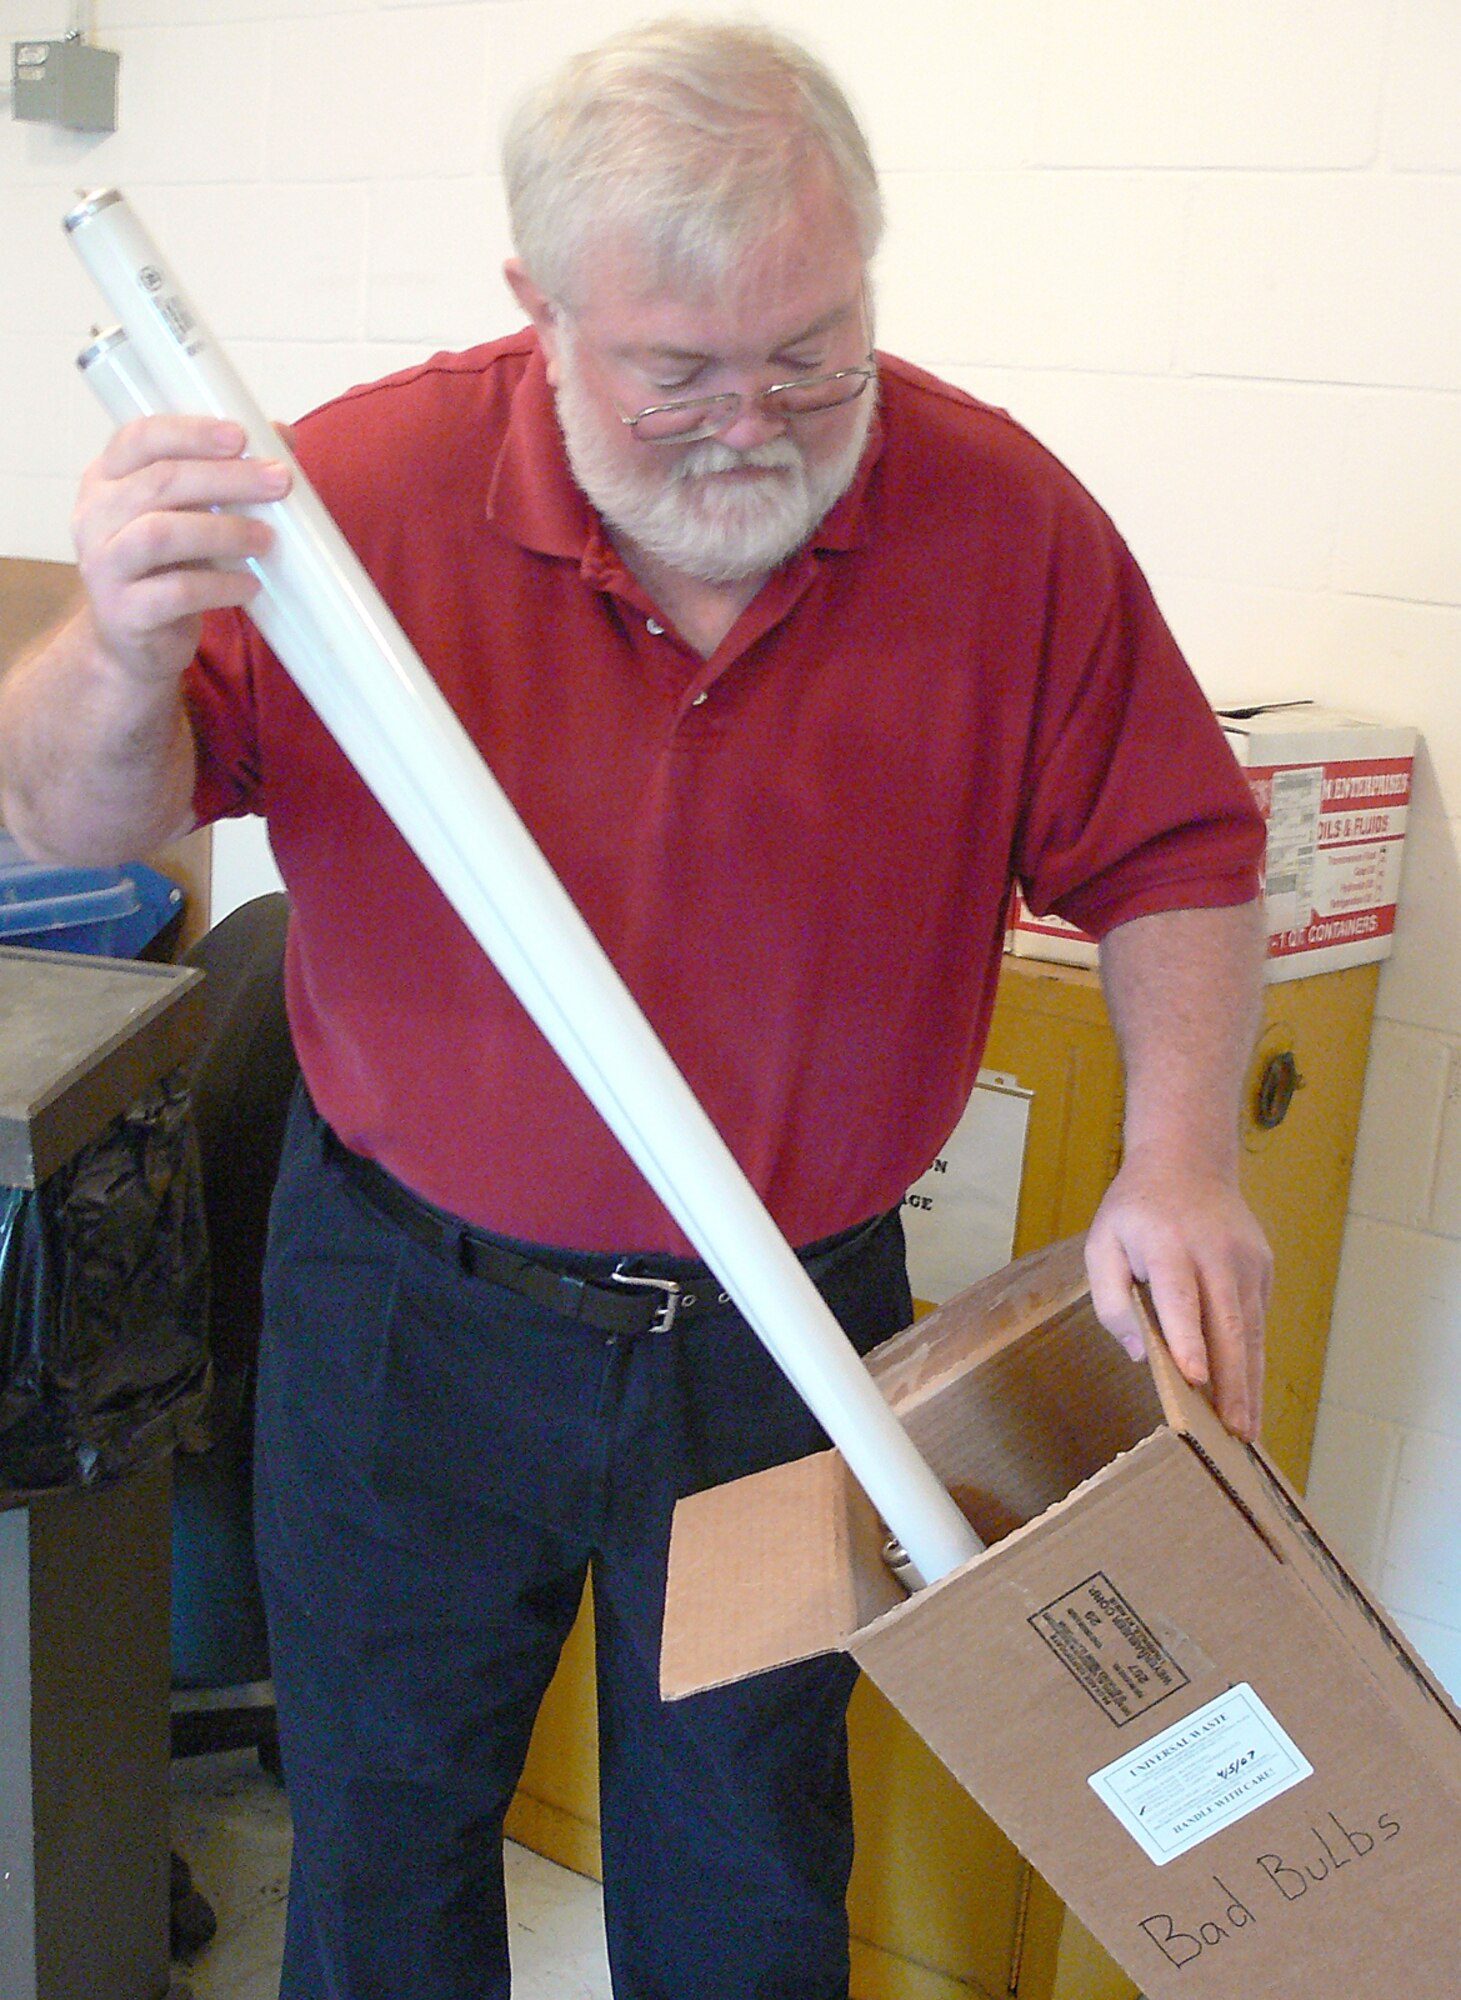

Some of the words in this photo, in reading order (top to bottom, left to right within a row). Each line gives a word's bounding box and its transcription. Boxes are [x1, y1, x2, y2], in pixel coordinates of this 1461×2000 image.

[1354, 815, 1389, 835] FLUIDS
[1308, 914, 1379, 943] CONTAINERS
[1130, 1733, 1188, 1777] UNIVERSAL
[1190, 1712, 1229, 1739] WASTE
[1173, 1805, 1214, 1834] HANDLE
[1214, 1784, 1244, 1809] WITH
[1138, 1876, 1256, 1969] Bad
